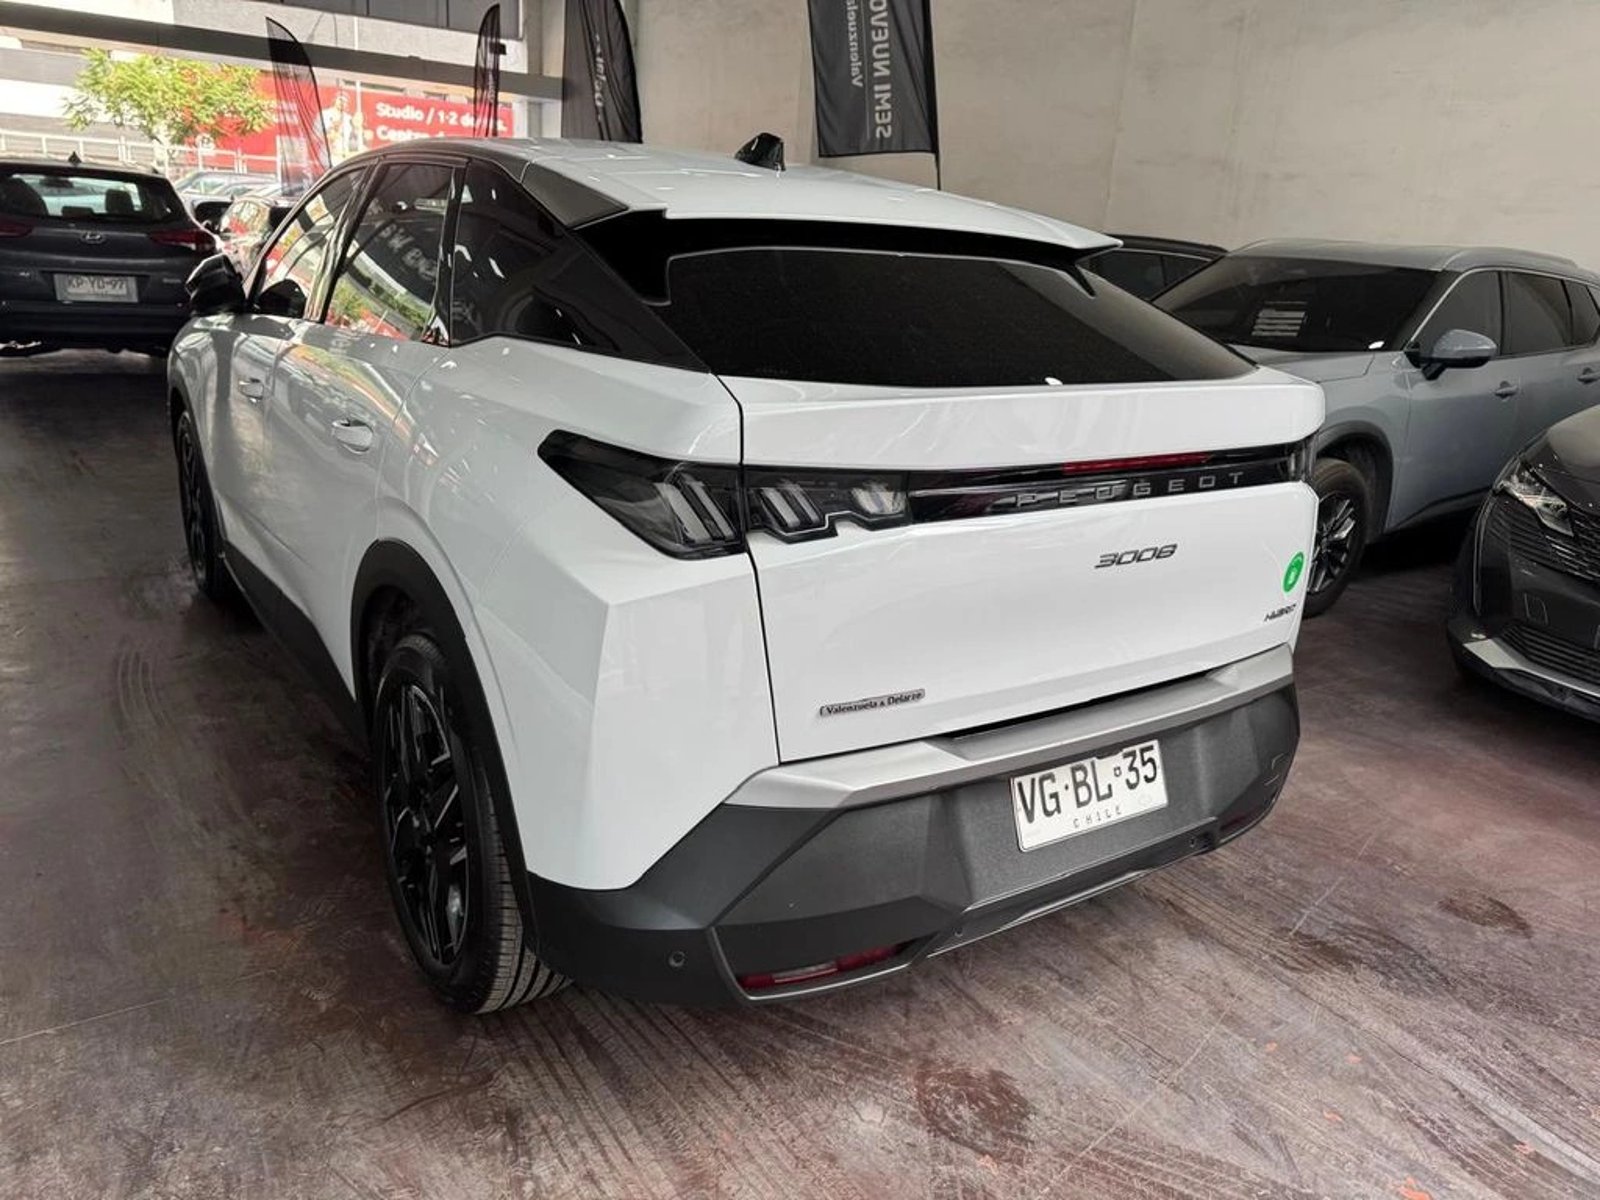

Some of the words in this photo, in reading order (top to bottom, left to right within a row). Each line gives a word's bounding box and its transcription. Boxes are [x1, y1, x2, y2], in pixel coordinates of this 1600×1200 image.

[375, 102, 424, 121] Studio
[1016, 471, 1244, 508] PEUGEOT
[1094, 543, 1178, 569] 3008
[1073, 805, 1122, 829] CHILE
